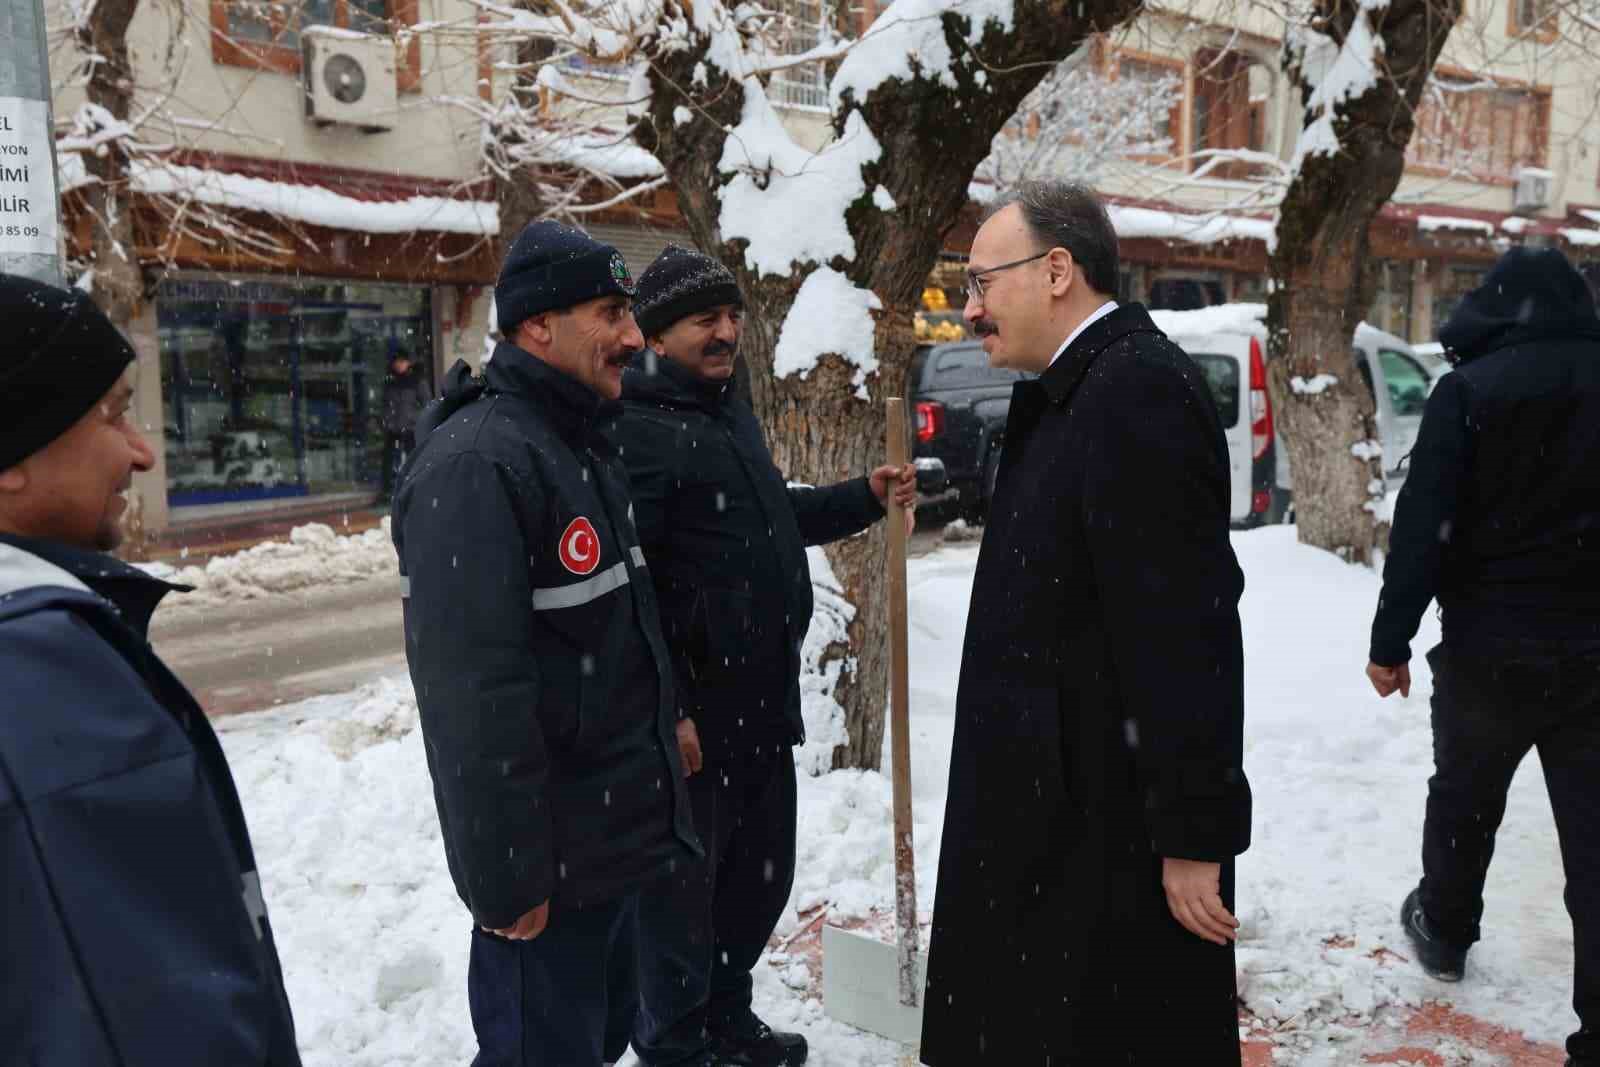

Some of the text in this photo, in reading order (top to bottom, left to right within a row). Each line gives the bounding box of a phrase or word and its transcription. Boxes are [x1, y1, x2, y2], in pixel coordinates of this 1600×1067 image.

[0, 144, 28, 156] YON
[6, 226, 20, 236] 85
[23, 226, 39, 237] 09
